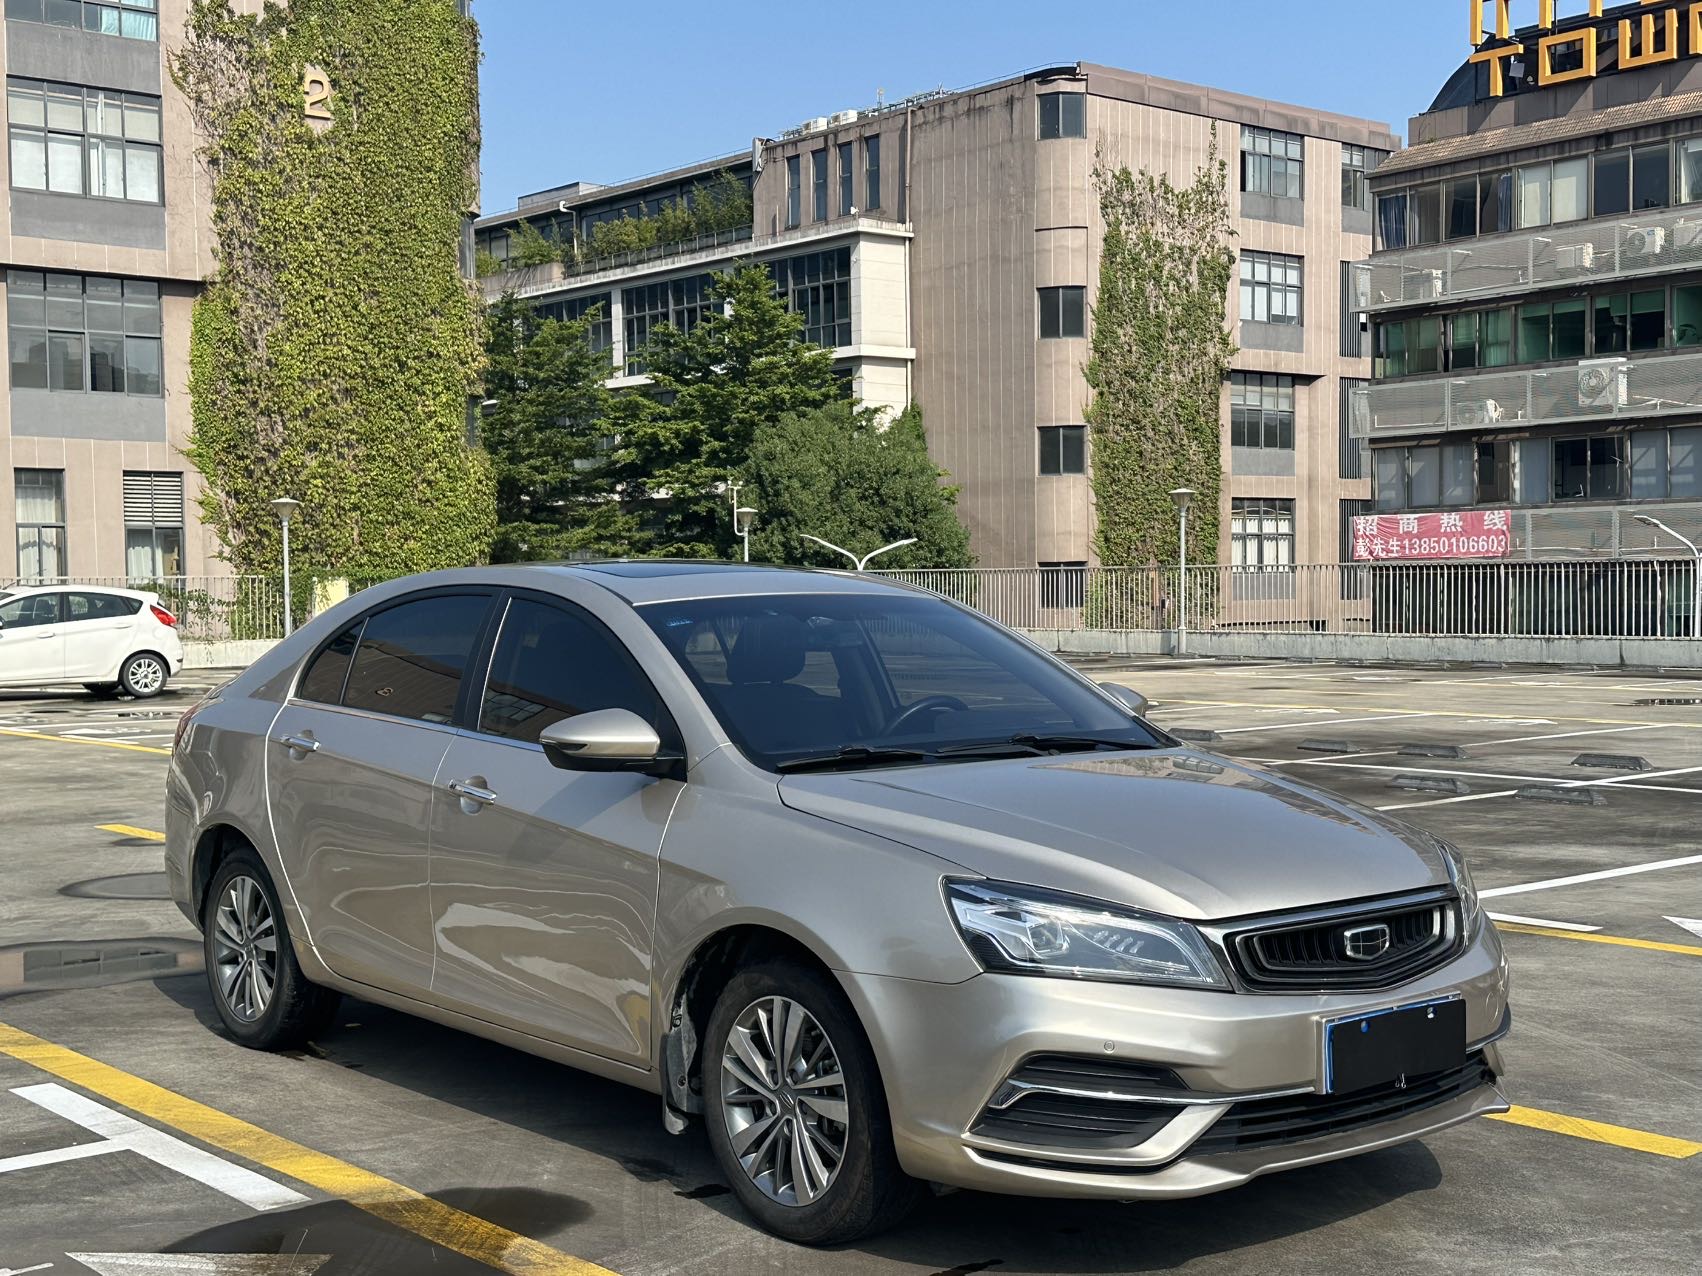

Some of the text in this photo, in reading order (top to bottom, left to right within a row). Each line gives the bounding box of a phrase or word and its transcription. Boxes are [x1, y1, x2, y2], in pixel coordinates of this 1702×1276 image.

[1469, 2, 1702, 96] TOW
[303, 71, 333, 119] 2
[1357, 510, 1507, 535] 招商热线
